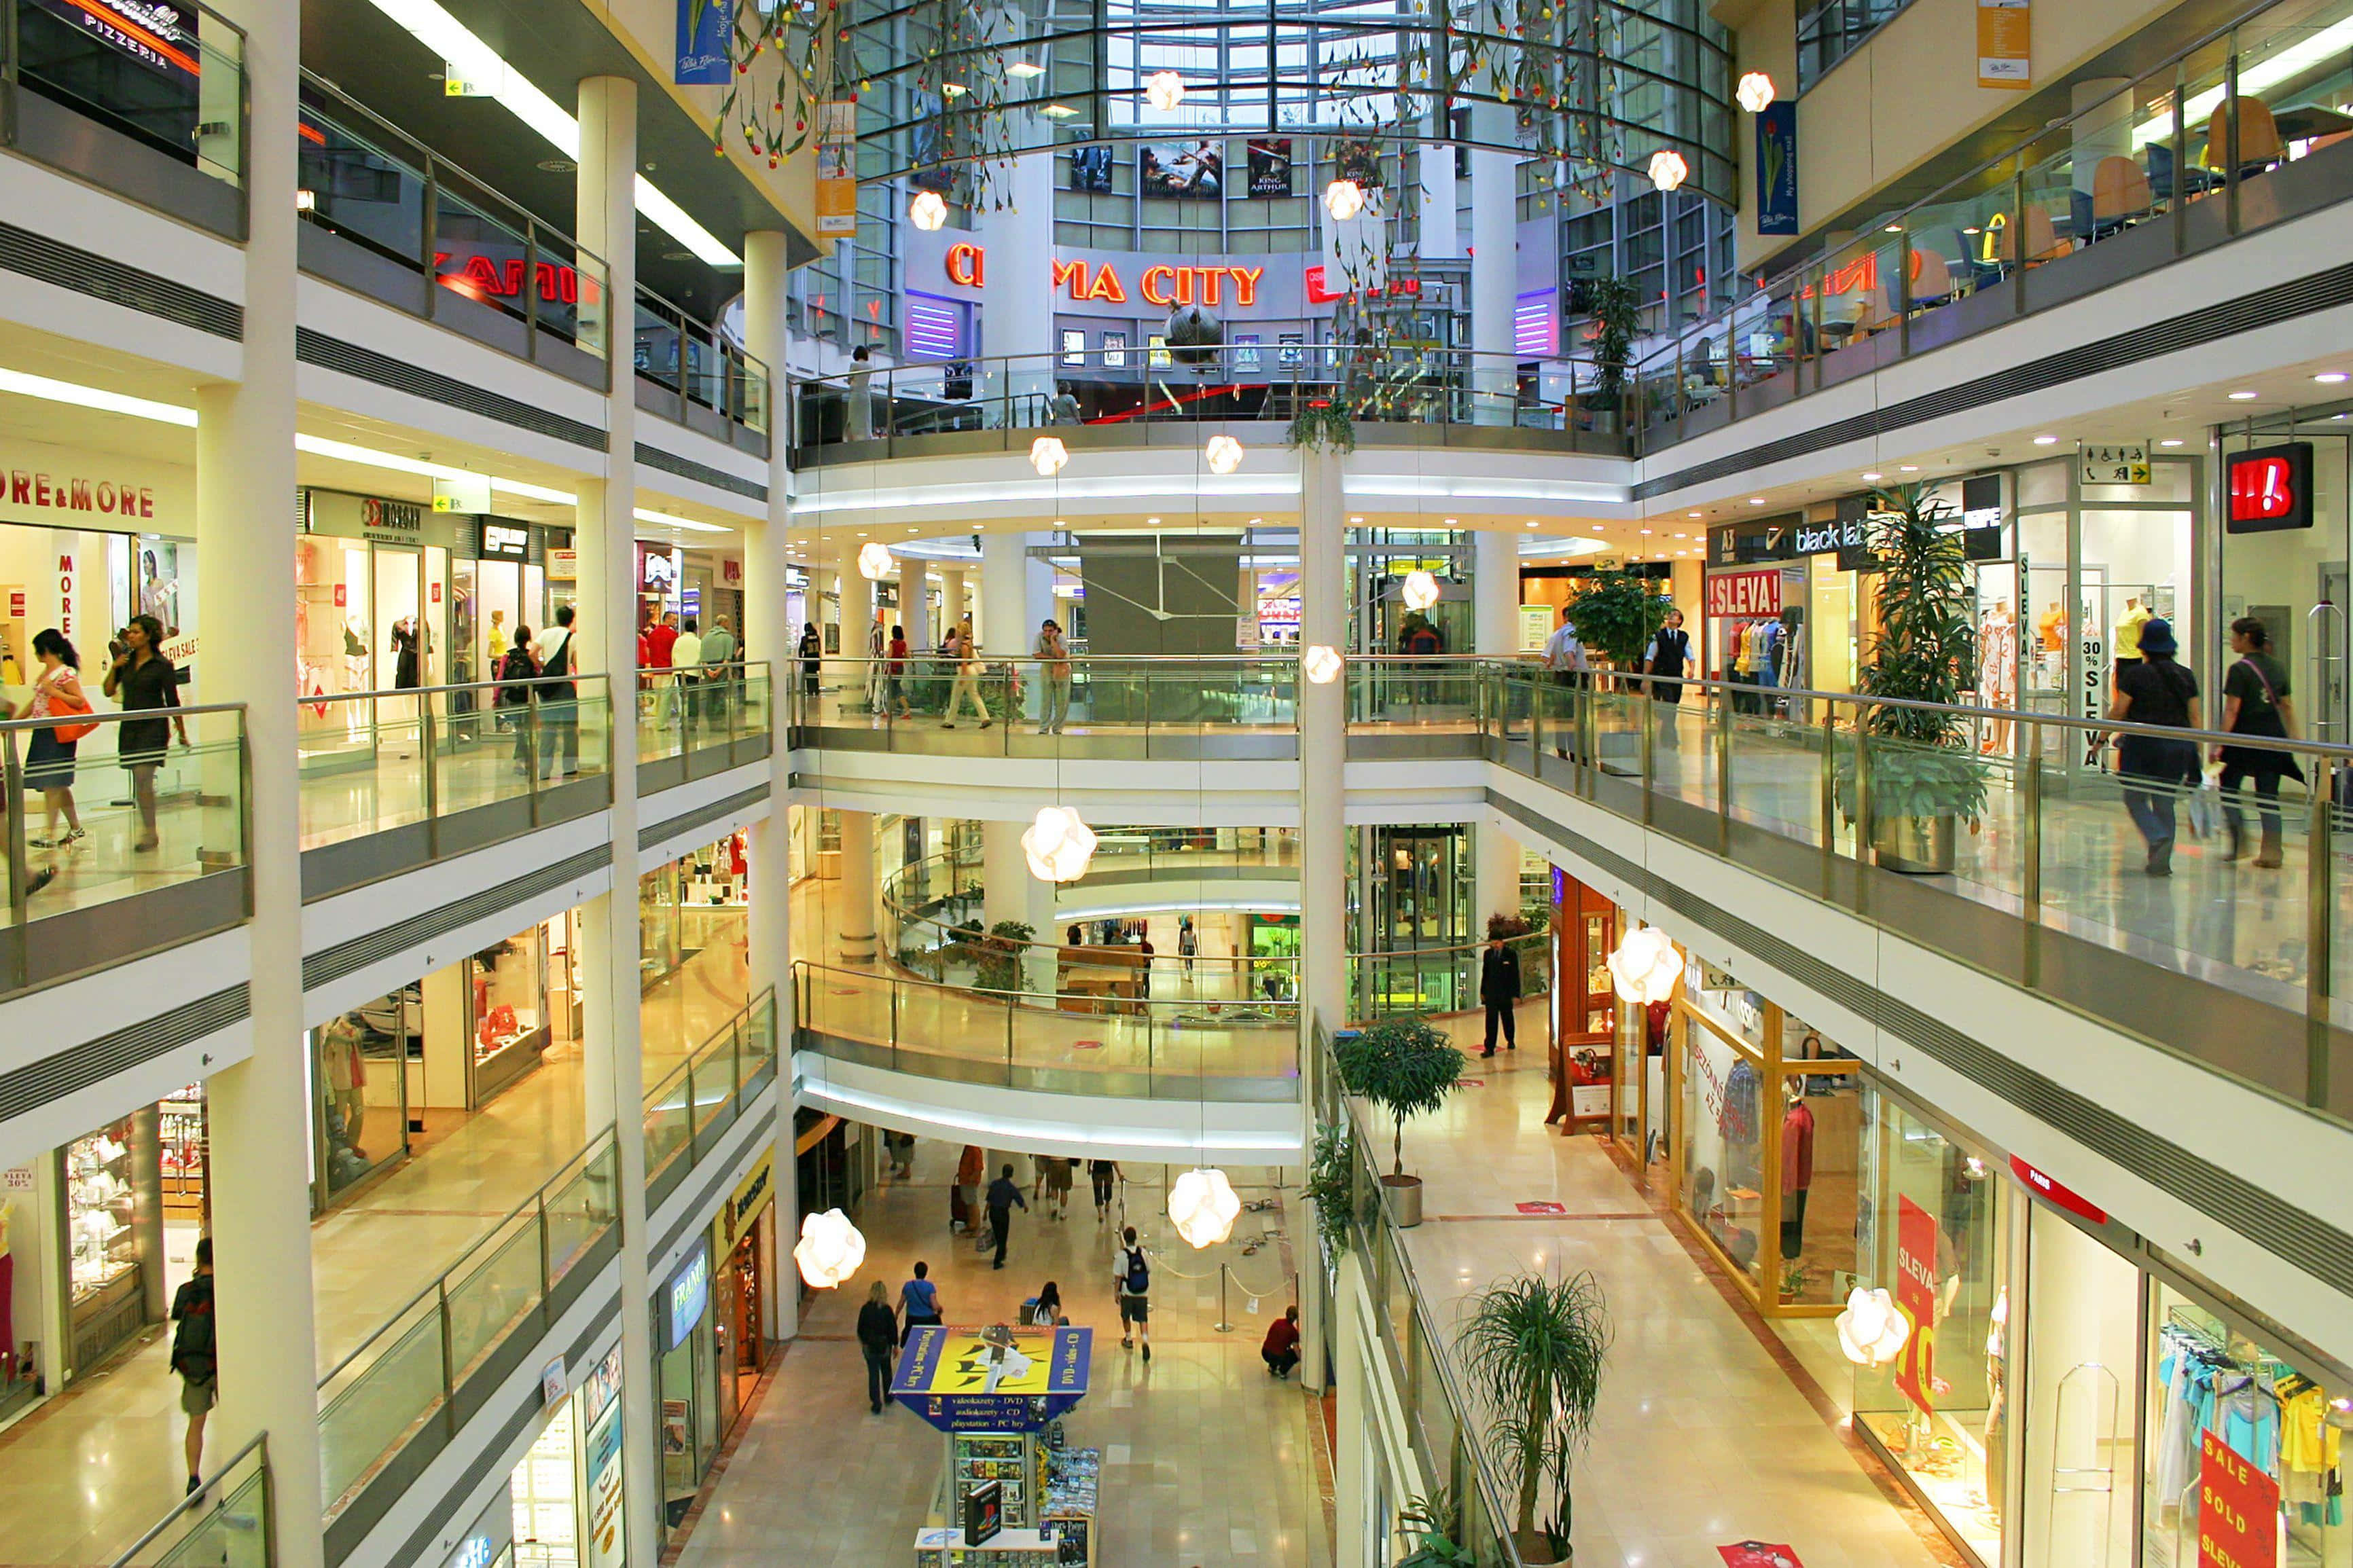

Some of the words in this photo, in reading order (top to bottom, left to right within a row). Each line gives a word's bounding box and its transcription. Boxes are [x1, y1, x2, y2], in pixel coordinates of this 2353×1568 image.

[85, 14, 167, 69] PIZZERIA
[1251, 183, 1287, 192] ARTHUR
[1258, 176, 1282, 185] KING
[1140, 266, 1263, 306] CITY
[1796, 523, 1840, 553] black
[59, 555, 73, 634] MORE
[2020, 558, 2028, 657] SLEVA
[2083, 641, 2100, 655] 30
[1899, 1247, 1935, 1294] SLEVA
[1062, 1368, 1075, 1385] DVD
[1004, 1397, 1024, 1405] DVD
[2204, 1438, 2248, 1486] SALE
[2204, 1486, 2246, 1535] SOLD
[2202, 1533, 2242, 1568] SLEV
